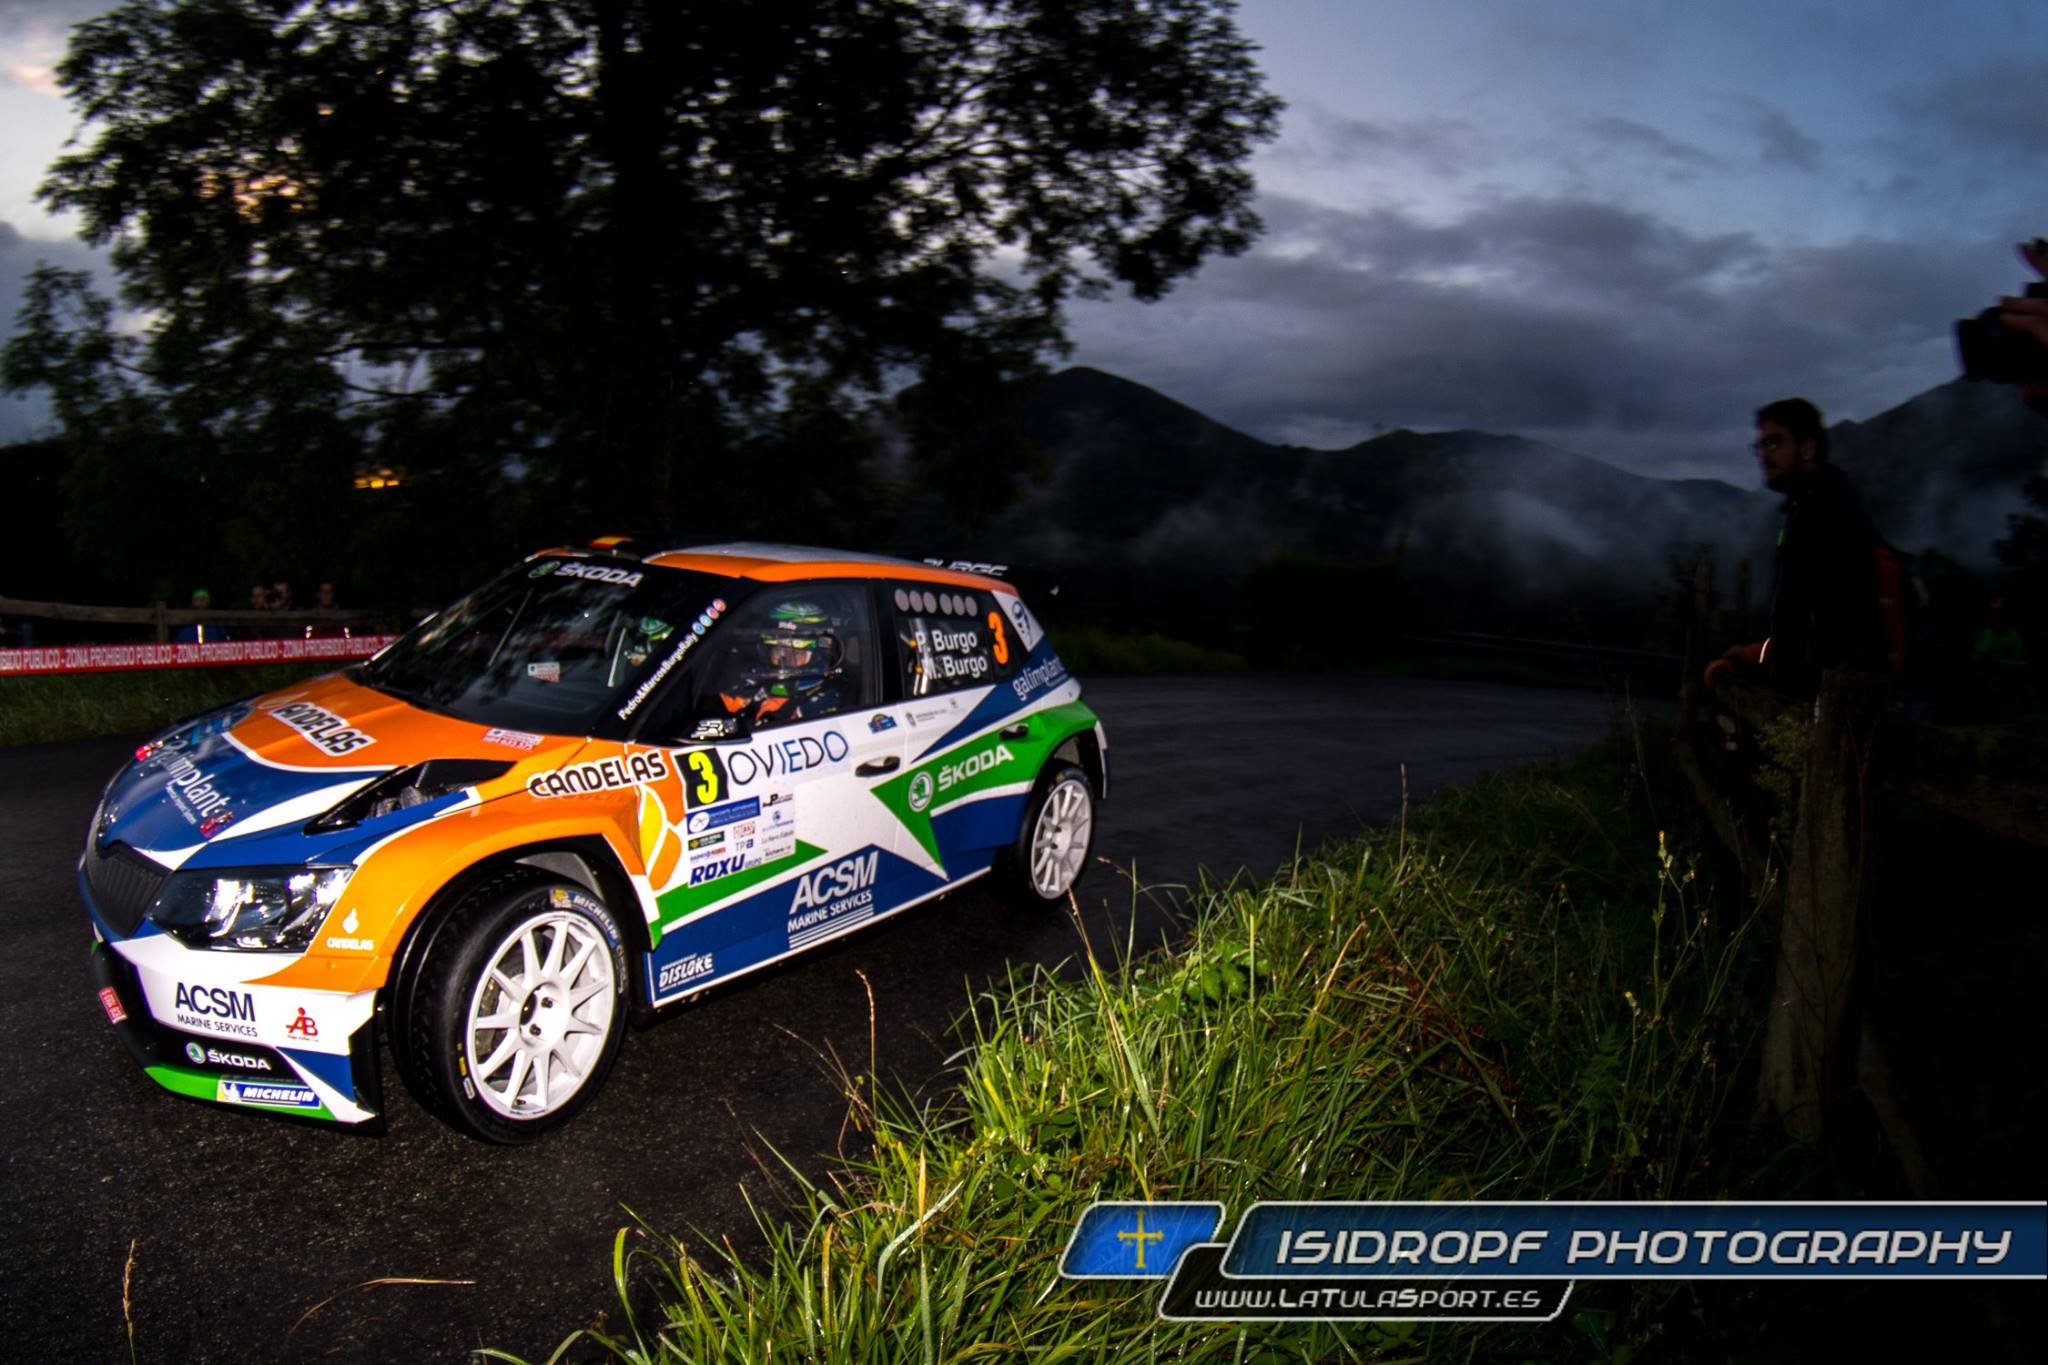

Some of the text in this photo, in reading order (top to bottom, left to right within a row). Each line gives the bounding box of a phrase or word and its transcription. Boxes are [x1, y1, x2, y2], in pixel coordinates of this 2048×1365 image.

[915, 630, 978, 654] P. Burgo
[988, 611, 1009, 665] 3
[944, 655, 987, 679] Burgo
[529, 752, 667, 796] CANDELAS
[688, 751, 718, 804] 3
[728, 731, 848, 785] OVIEDO
[938, 744, 1014, 792] ŠKODA
[690, 853, 745, 885] ROXU
[789, 851, 879, 915] ACSM
[573, 895, 620, 939] MICHELIN
[787, 890, 873, 933] MARINE SERVICES
[176, 982, 256, 1022] ACSM
[177, 1013, 258, 1037] MARINE SERVICES
[208, 1050, 272, 1071] ŠKODA
[243, 1086, 315, 1102] MICHELIN
